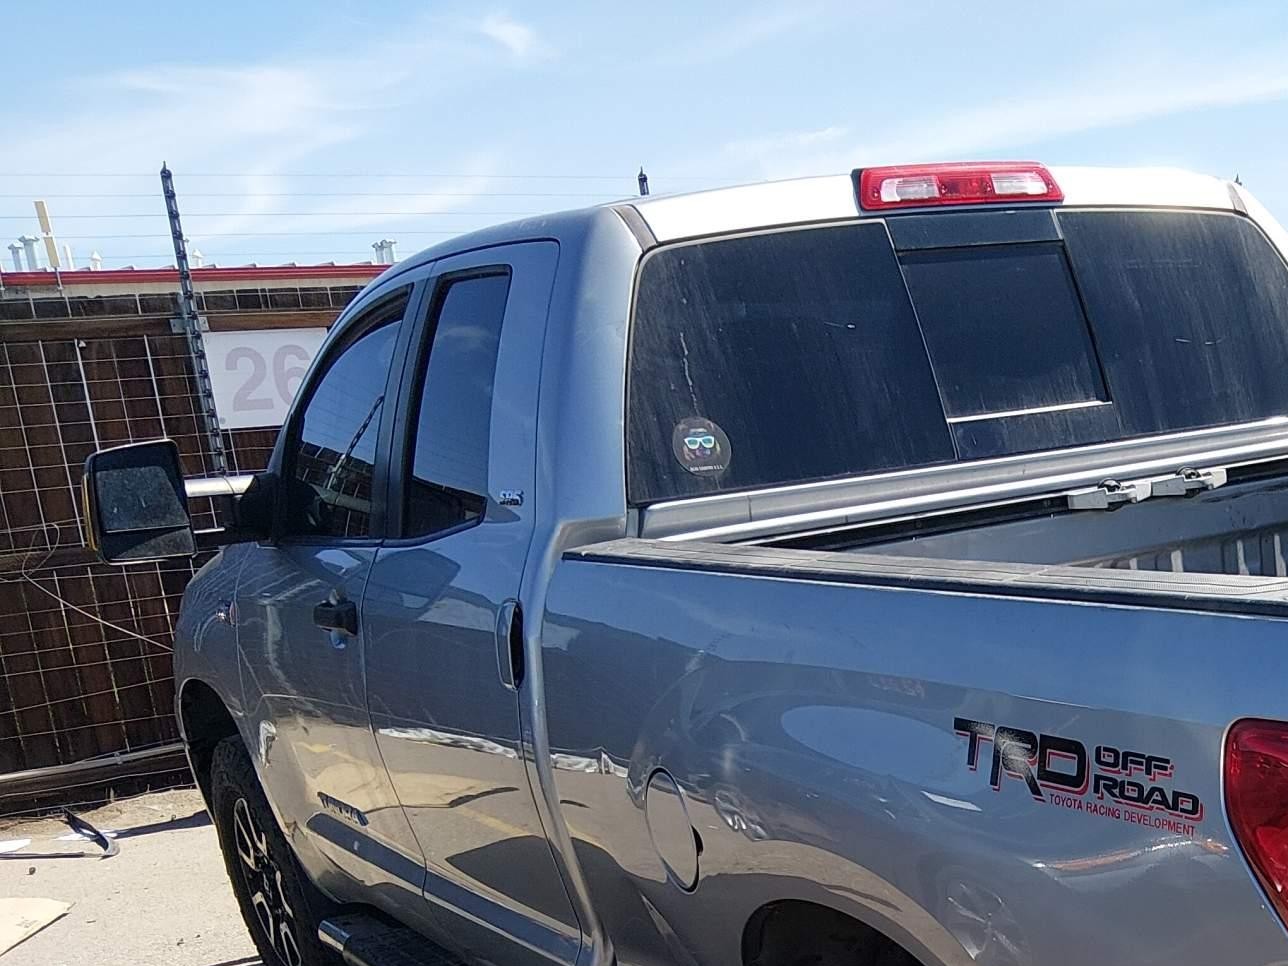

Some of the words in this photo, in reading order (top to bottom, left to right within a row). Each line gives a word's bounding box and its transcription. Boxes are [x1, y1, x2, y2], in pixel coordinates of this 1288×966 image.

[225, 344, 311, 411] 26
[953, 717, 1090, 802] TRD
[1094, 745, 1175, 781] OFF
[1049, 793, 1083, 811] TOYOTA
[1086, 801, 1121, 820] RACING
[1123, 809, 1196, 837] DEVELOPMENT
[1092, 773, 1204, 822] ROAD
